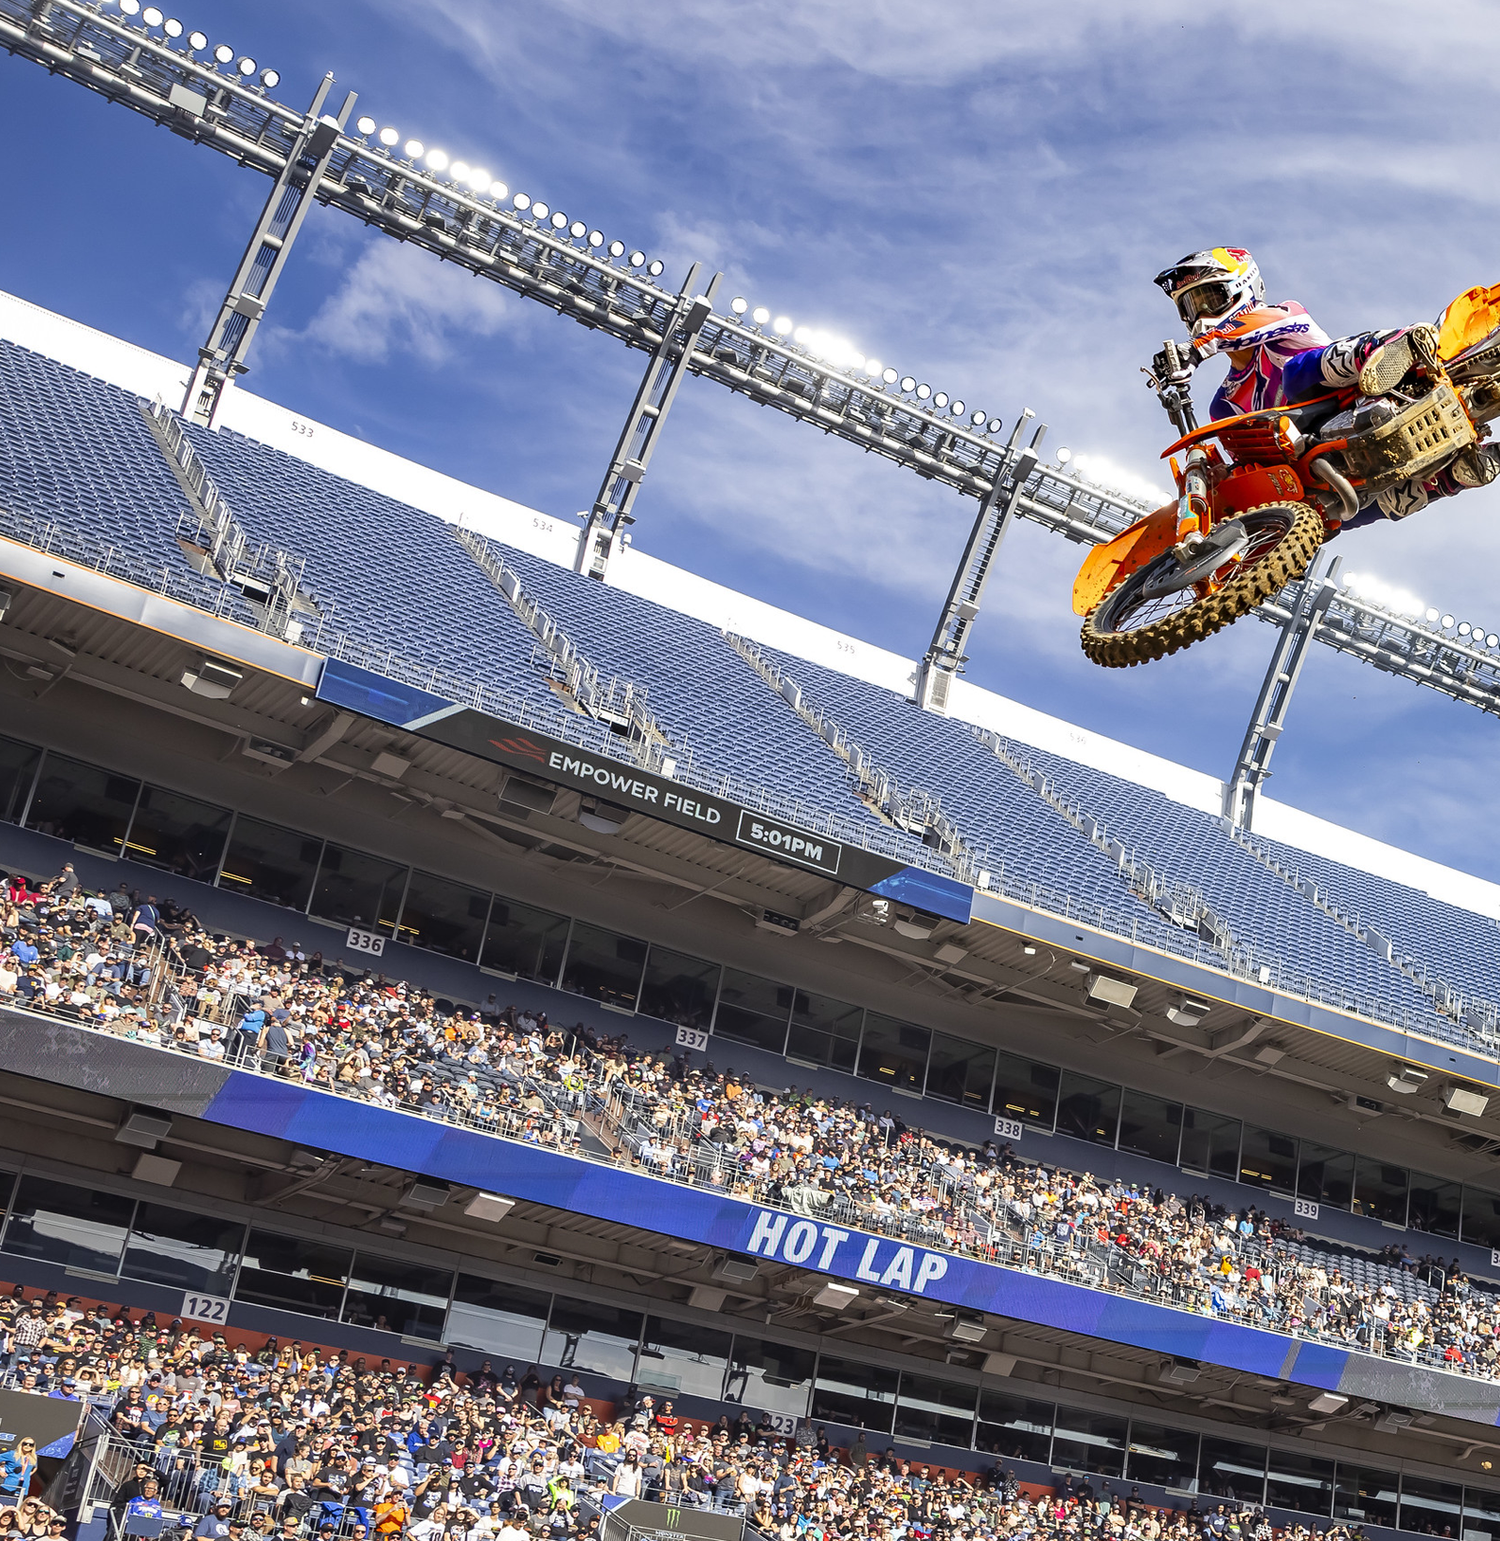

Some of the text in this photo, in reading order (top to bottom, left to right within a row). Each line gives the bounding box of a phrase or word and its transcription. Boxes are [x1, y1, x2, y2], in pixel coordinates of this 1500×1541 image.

[291, 421, 314, 438] 533
[532, 518, 553, 532] 534
[837, 640, 855, 654] 535
[549, 752, 823, 861] EMPOWER FIELD 5:01PM
[349, 931, 382, 952] 336
[678, 1029, 706, 1048] 337
[996, 1120, 1020, 1137] 338
[1296, 1201, 1317, 1216] 339
[746, 1210, 949, 1293] HOT LAP
[187, 1297, 226, 1319] 122
